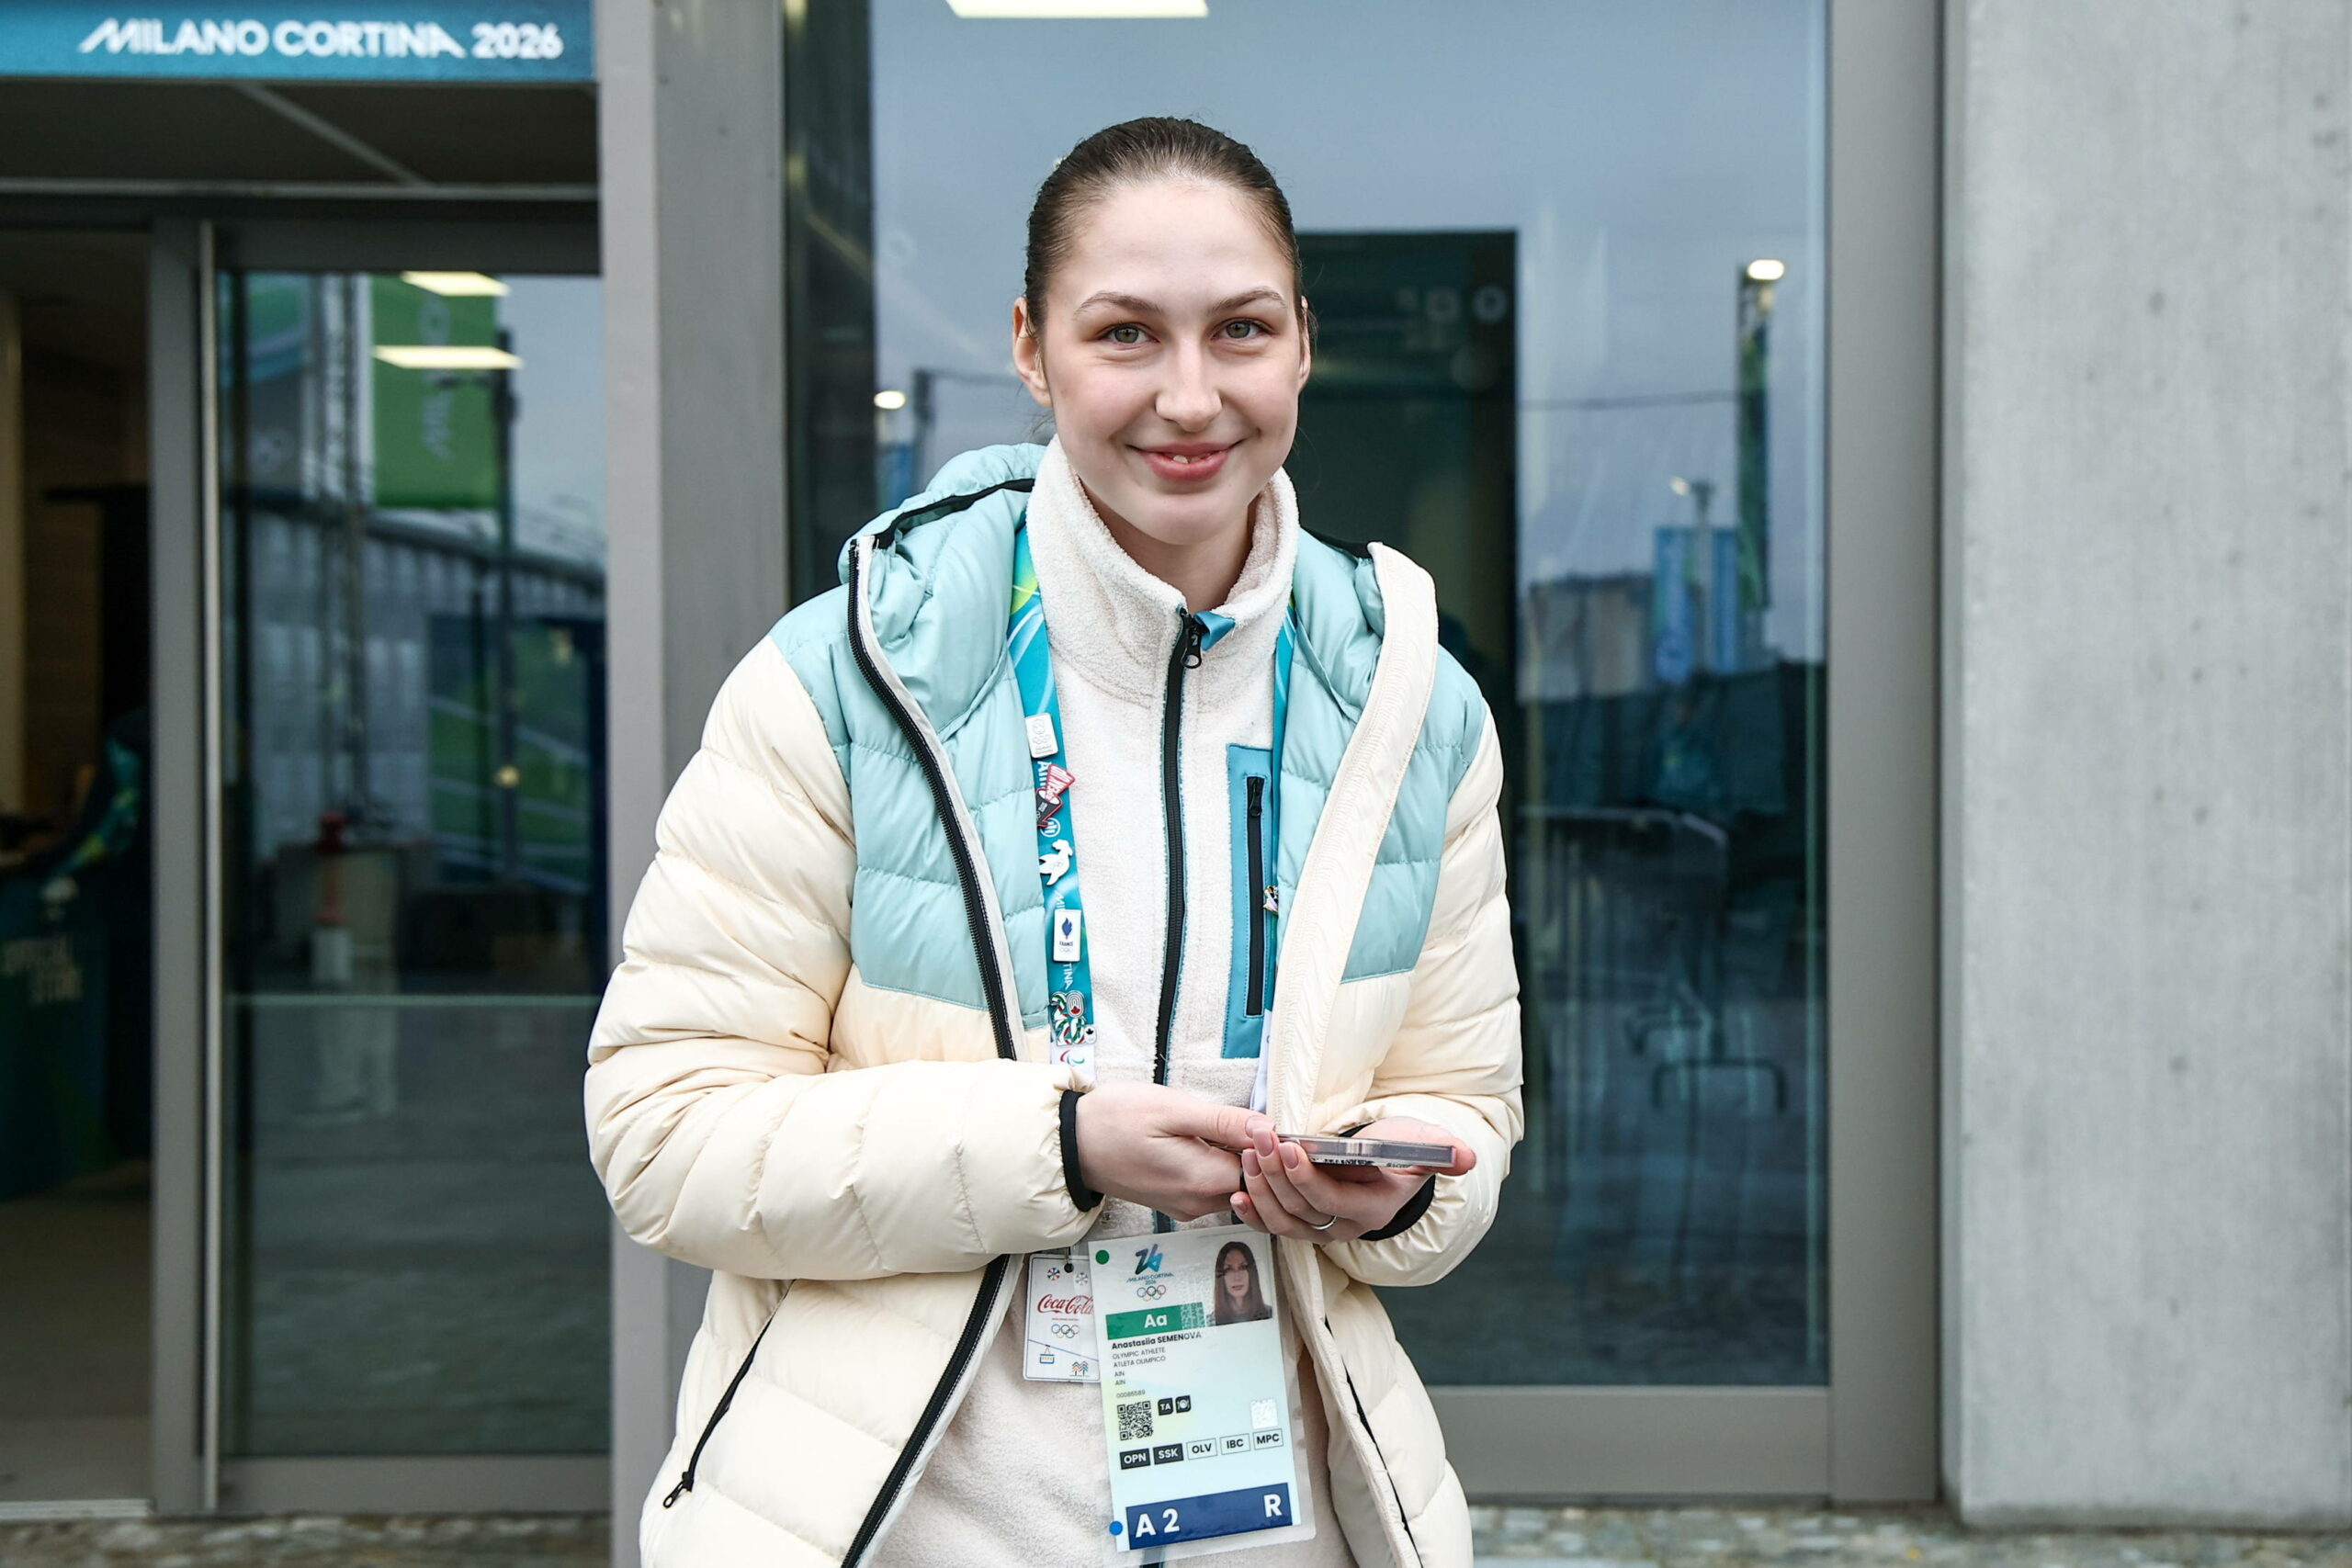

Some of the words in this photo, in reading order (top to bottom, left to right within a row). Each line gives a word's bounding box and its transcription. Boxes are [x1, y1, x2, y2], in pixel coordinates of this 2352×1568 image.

[77, 17, 270, 55] MILANO
[274, 19, 468, 57] CORTINA
[471, 21, 565, 60] 2026
[1036, 1293, 1094, 1315] Coca-Cola
[1144, 1314, 1168, 1329] Aa
[1157, 1331, 1202, 1344] SEMENOVA
[1112, 1351, 1140, 1360] OLYMPIC
[1140, 1347, 1166, 1356] ATHLETE
[1114, 1359, 1136, 1369] ATLETA
[1160, 1404, 1171, 1412] TA
[1123, 1452, 1148, 1465] OPN
[1158, 1448, 1179, 1460] SSK
[1192, 1443, 1212, 1454] OLV
[1227, 1438, 1244, 1450] IBC
[1256, 1433, 1280, 1445] MPC
[1135, 1513, 1157, 1539] A
[1162, 1507, 1181, 1533] 2
[1263, 1493, 1283, 1518] R
